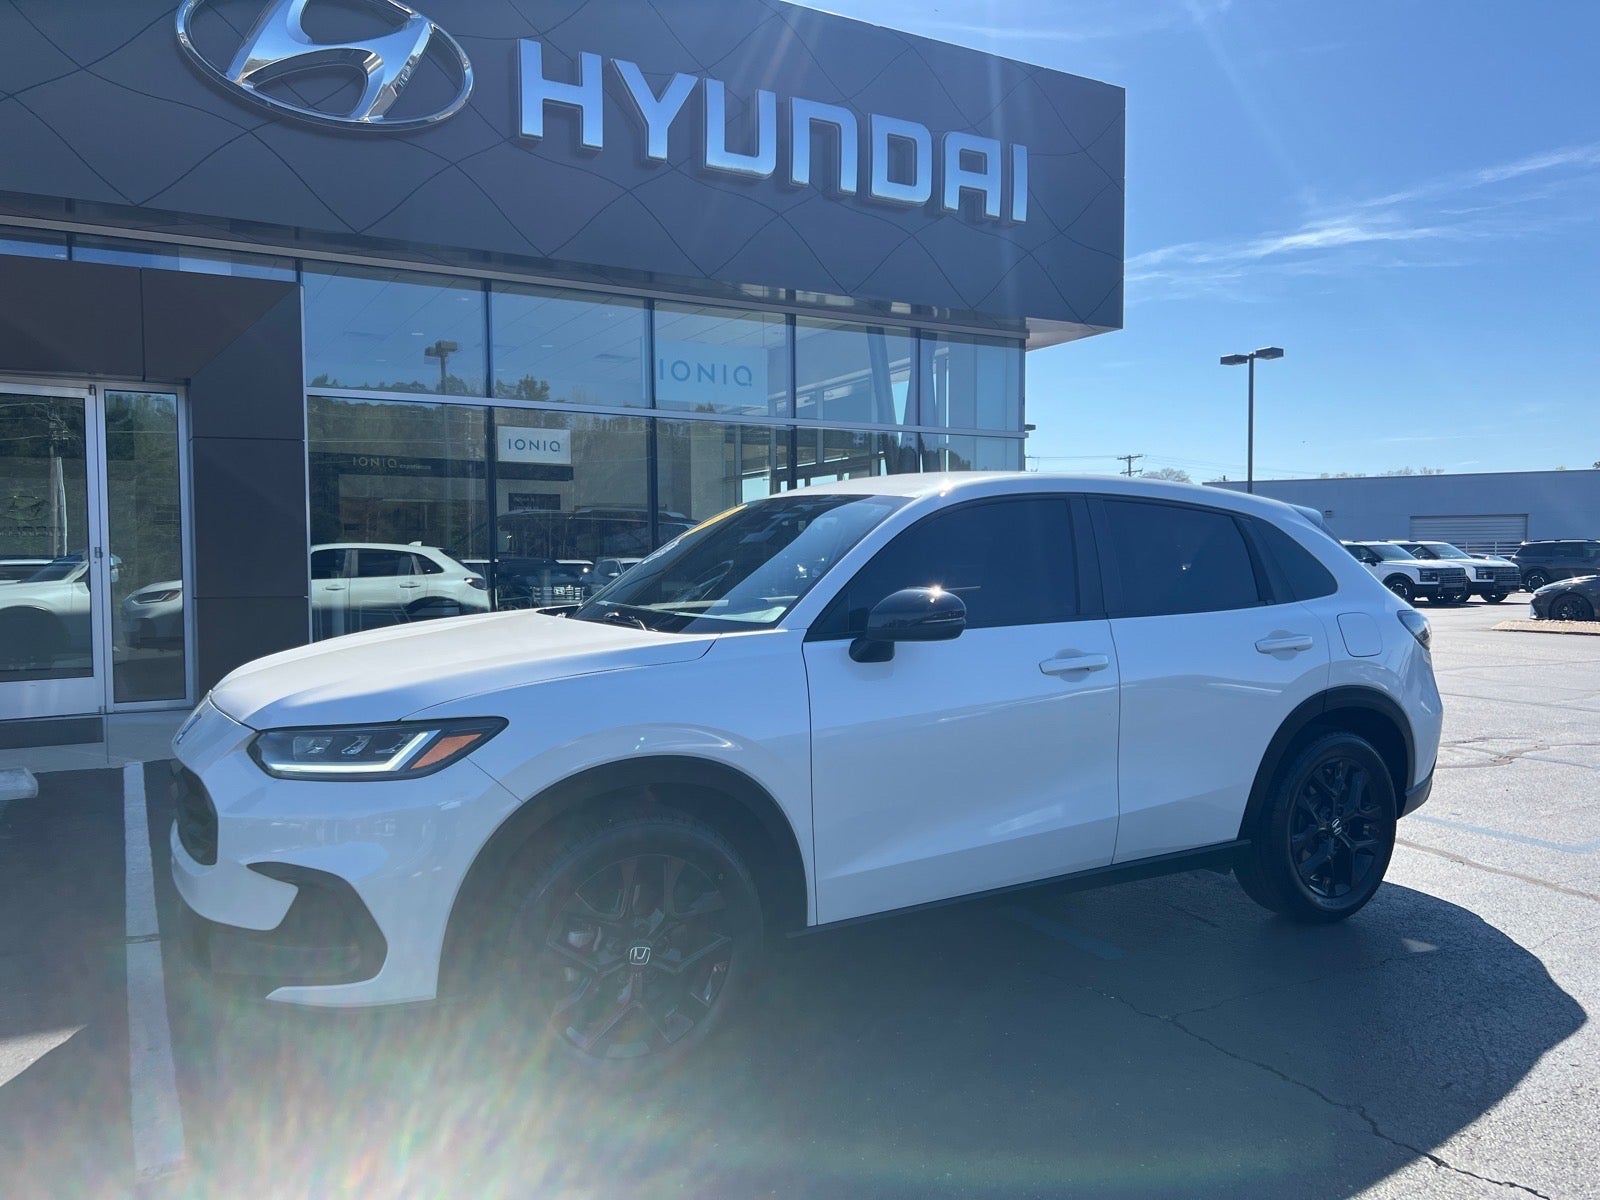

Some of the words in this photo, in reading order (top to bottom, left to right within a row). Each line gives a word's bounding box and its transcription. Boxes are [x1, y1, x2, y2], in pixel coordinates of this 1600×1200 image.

[517, 38, 1027, 223] HYUNDAI
[659, 358, 753, 387] IONIQ
[507, 438, 561, 452] IONIQ
[352, 456, 398, 468] IONIQ
